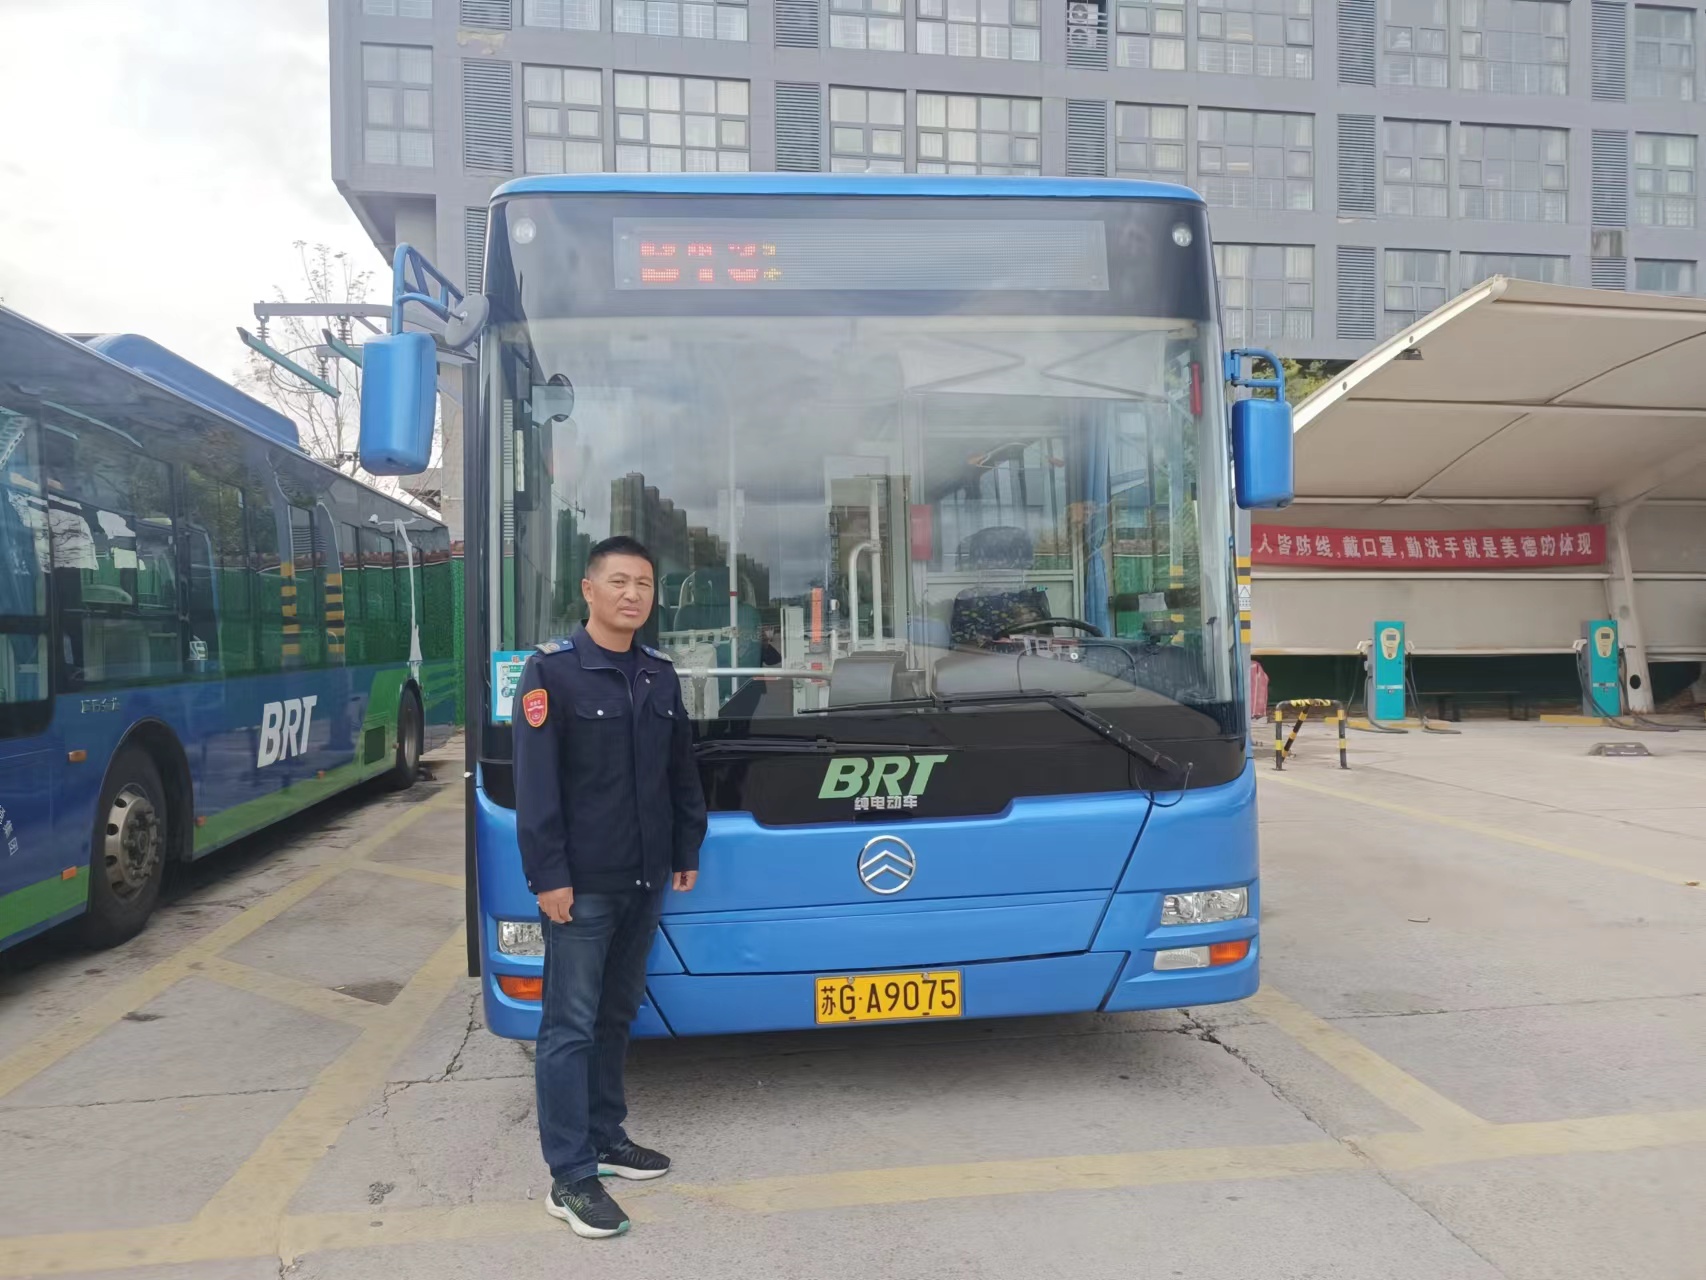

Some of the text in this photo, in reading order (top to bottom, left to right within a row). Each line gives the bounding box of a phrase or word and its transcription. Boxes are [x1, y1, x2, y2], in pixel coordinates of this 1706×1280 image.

[1250, 532, 1592, 559] 人皆防线，戴口罩，勤洗手就是美德的体现
[257, 695, 318, 768] BRT
[818, 754, 949, 799] BRT
[854, 795, 918, 811] 纯电动车
[821, 979, 957, 1016] 苏G·A9075
